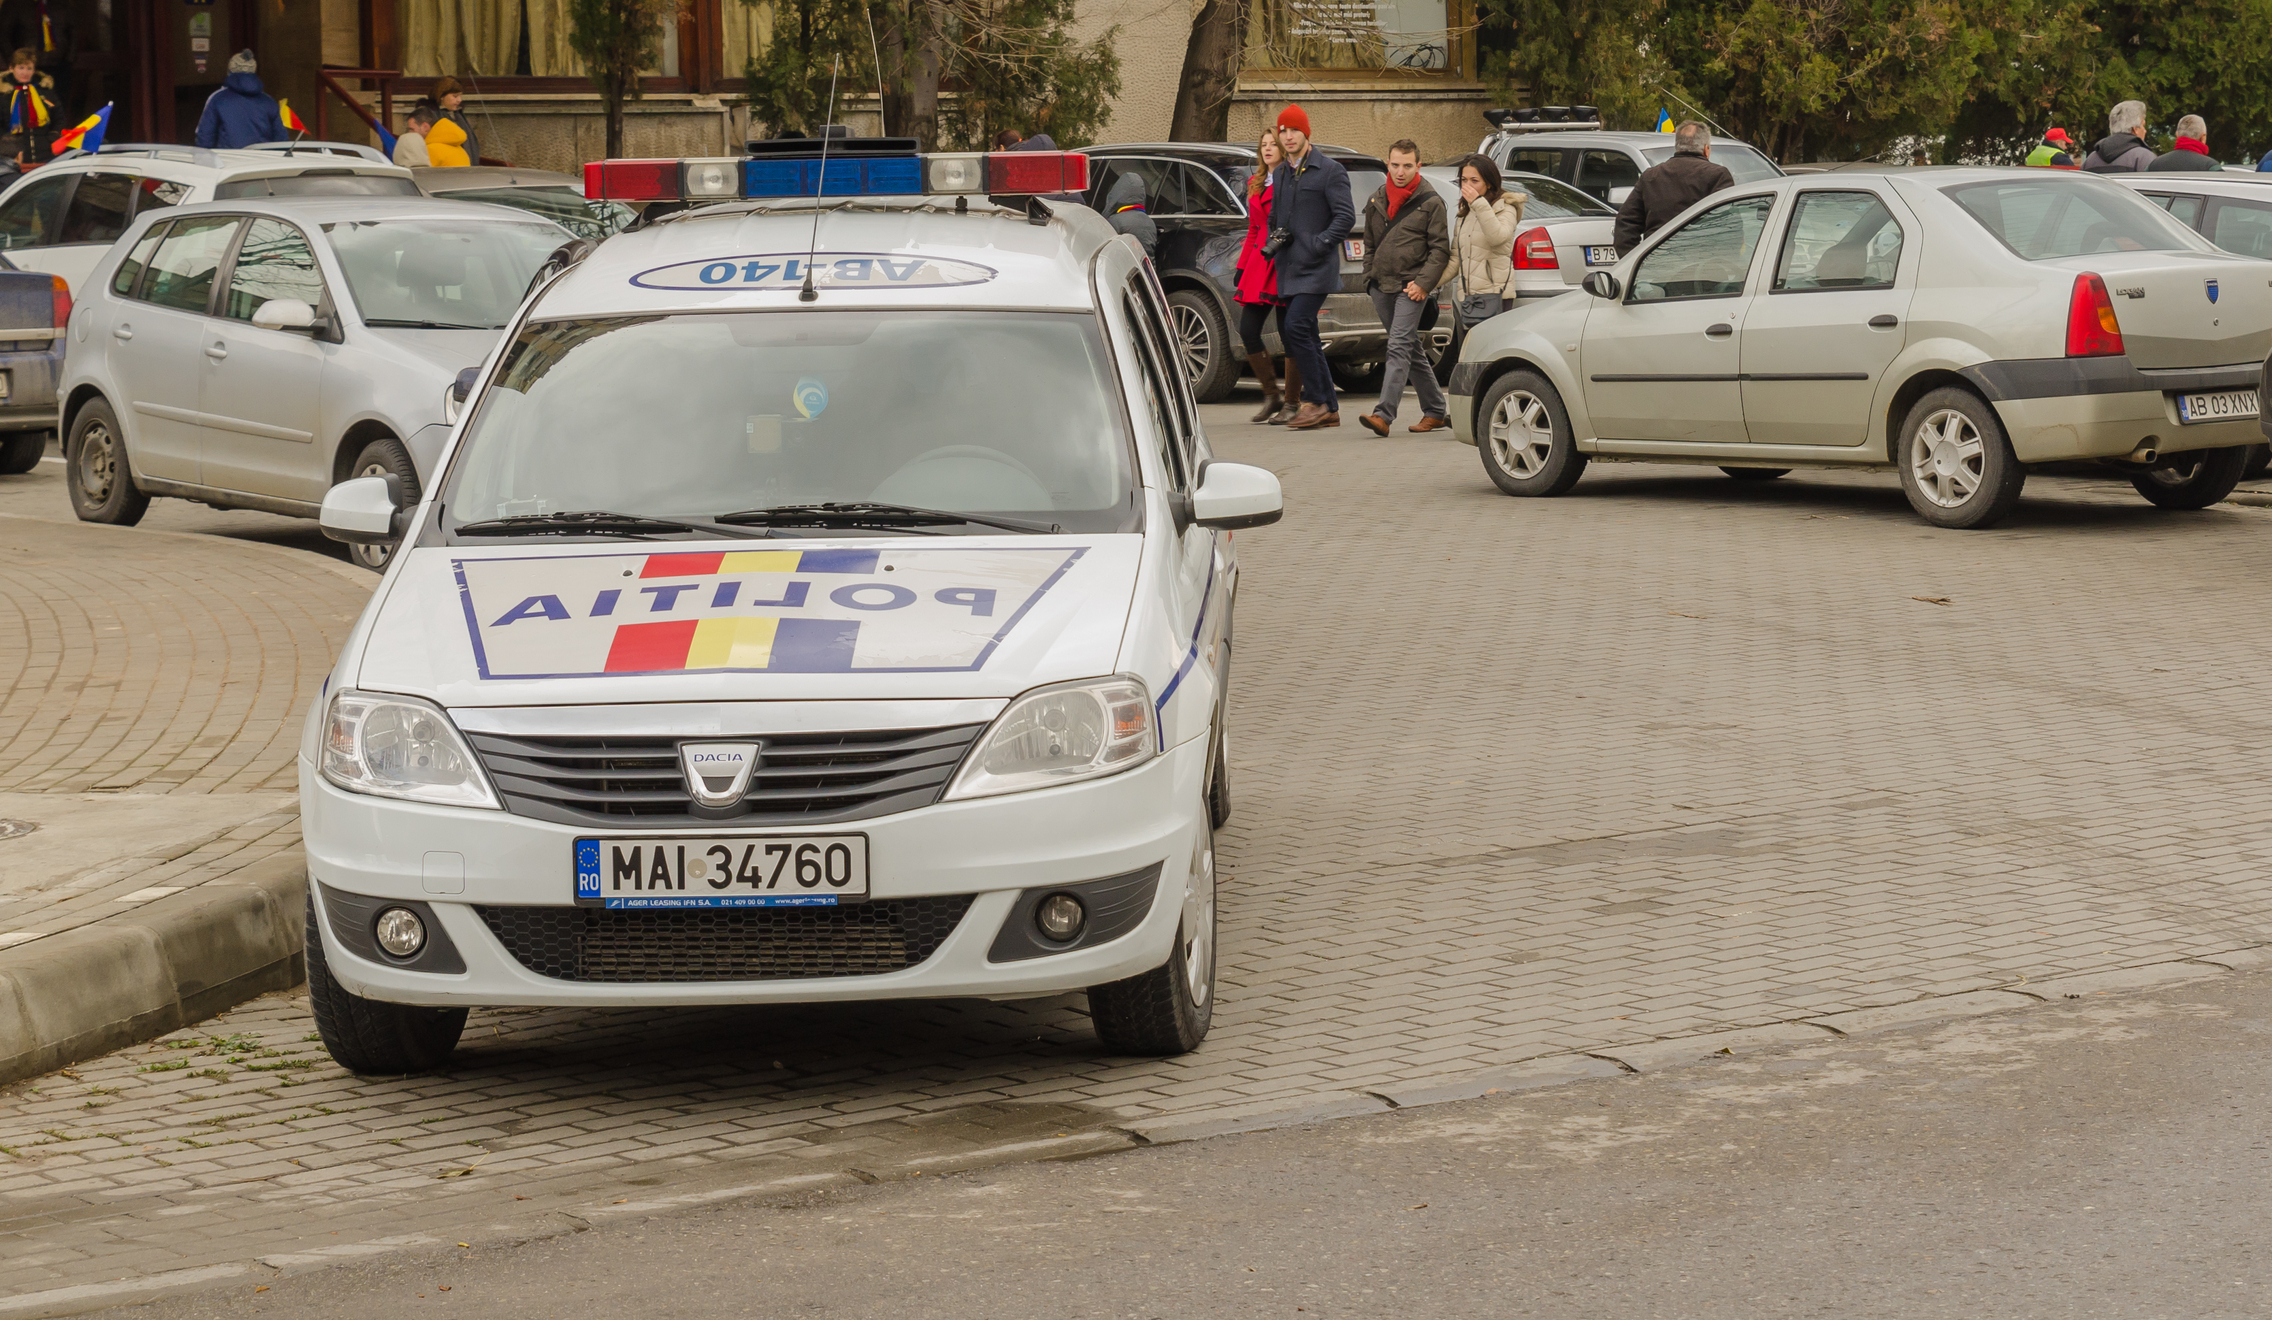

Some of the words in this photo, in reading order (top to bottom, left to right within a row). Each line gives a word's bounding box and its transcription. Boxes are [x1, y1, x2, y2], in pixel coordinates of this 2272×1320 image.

[1353, 242, 1362, 255] B
[1603, 248, 1616, 261] 79
[699, 258, 927, 285] AB-140
[2190, 396, 2208, 417] AB
[2211, 395, 2229, 415] 03
[2228, 392, 2258, 414] XNX
[693, 752, 744, 763] DACIA
[611, 845, 686, 891] MAI
[705, 842, 852, 890] 34760
[579, 873, 600, 892] RO
[627, 899, 648, 907] AGER
[650, 899, 682, 907] LEASING
[697, 899, 712, 907] S.A.
